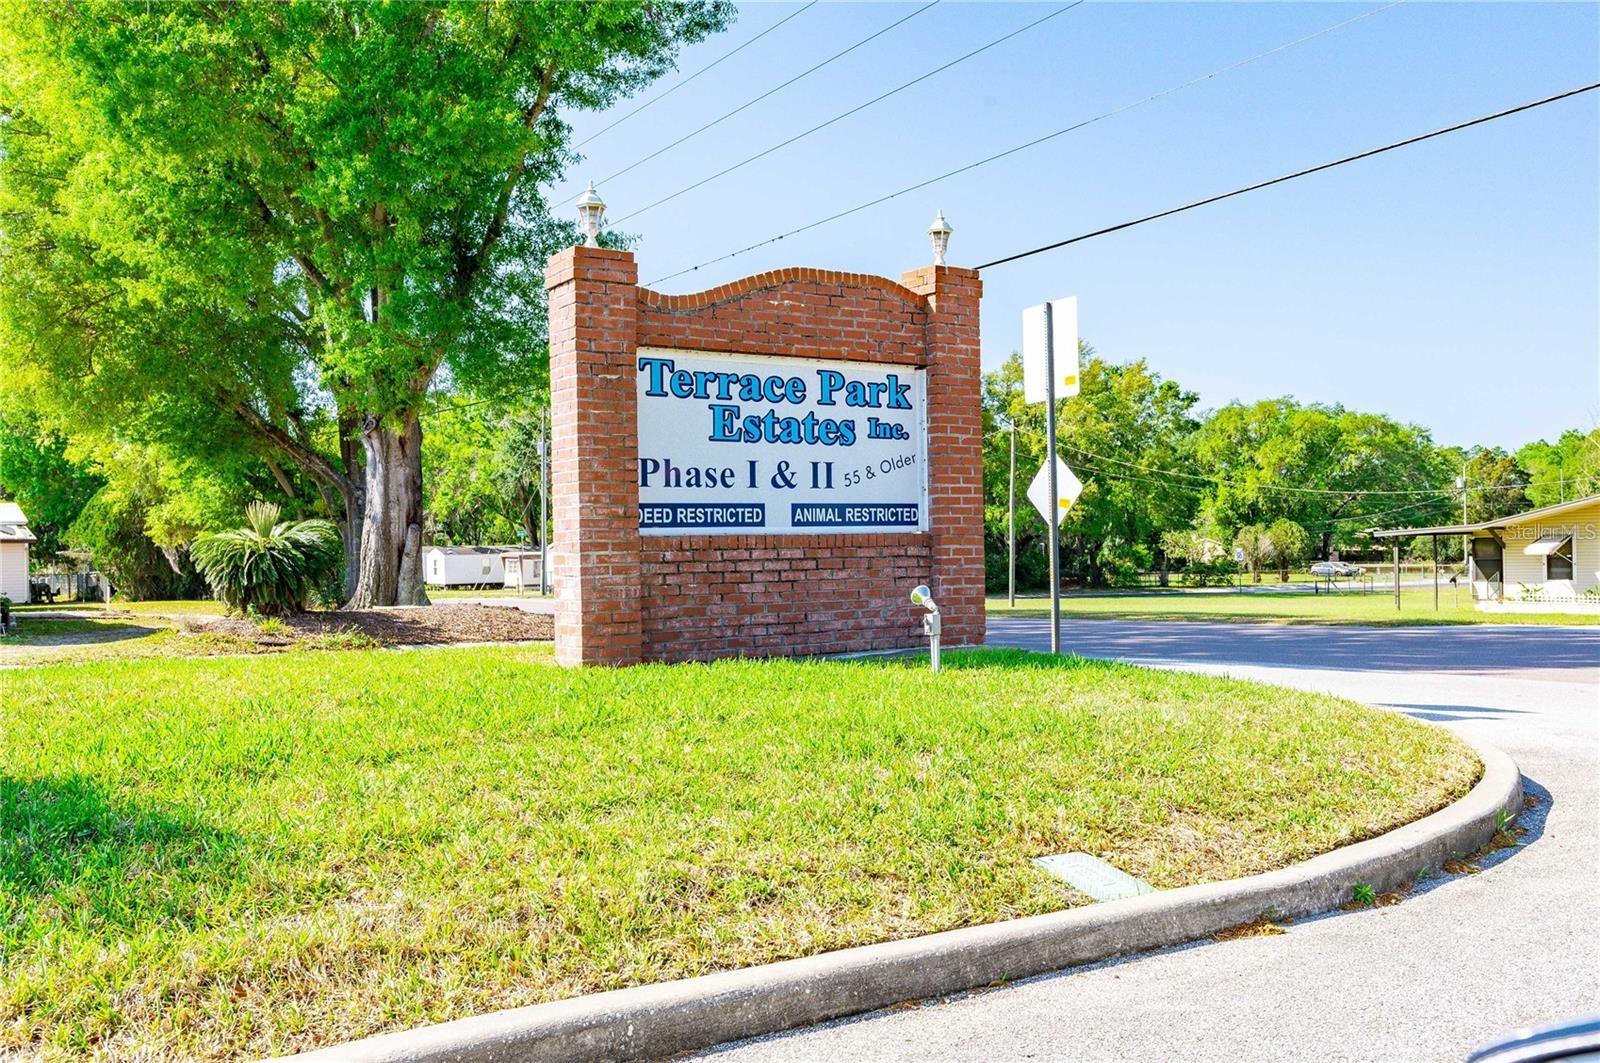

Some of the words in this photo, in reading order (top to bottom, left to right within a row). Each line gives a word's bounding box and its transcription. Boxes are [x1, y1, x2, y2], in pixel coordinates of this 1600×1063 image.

[638, 357, 806, 404] Terrace
[816, 369, 913, 410] Park
[708, 404, 857, 446] Estates
[867, 417, 910, 440] Inc.
[639, 457, 735, 489] Phase
[746, 460, 760, 488] I
[770, 460, 798, 490] &
[809, 461, 835, 489] II
[844, 470, 861, 488] 55
[865, 465, 877, 480] &
[879, 453, 917, 474] Older
[677, 507, 763, 523] RESTRICTED
[794, 507, 842, 523] ANIMAL
[845, 507, 918, 522] RESTRICTED
